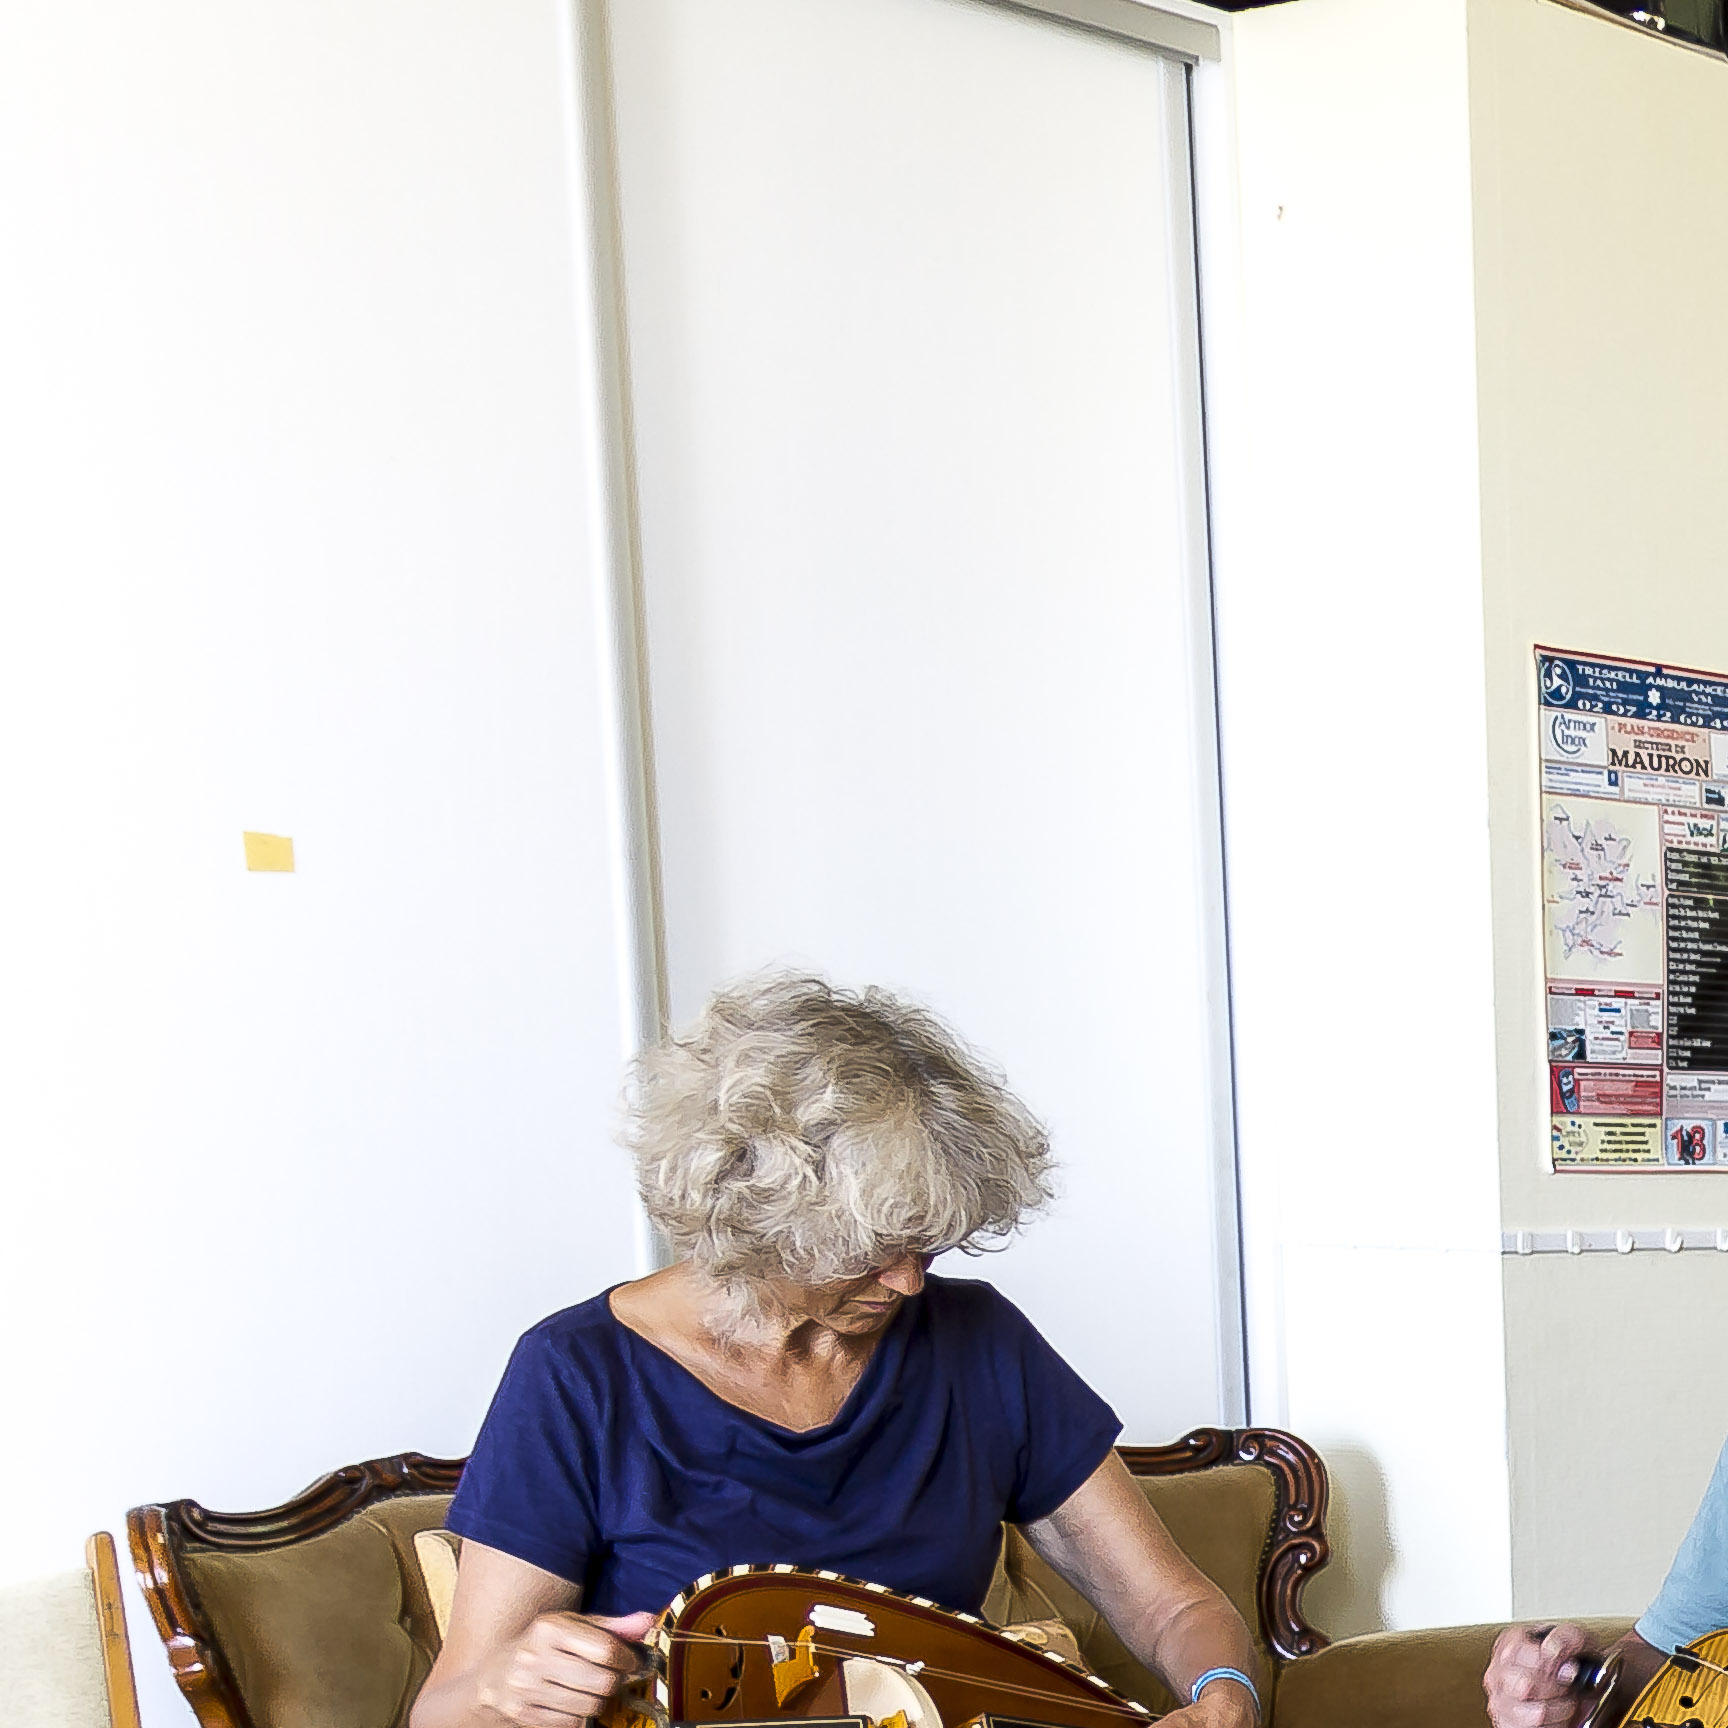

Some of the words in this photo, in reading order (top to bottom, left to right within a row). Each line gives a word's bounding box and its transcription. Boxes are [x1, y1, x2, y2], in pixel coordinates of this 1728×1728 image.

[1576, 664, 1640, 684] TRISKELL
[1588, 677, 1618, 690] TAXI
[1577, 699, 1604, 713] 02
[1611, 703, 1637, 717] 97
[1645, 708, 1672, 722] 22
[1559, 713, 1597, 733] Armor
[1561, 729, 1589, 749] Inox
[1609, 748, 1710, 778] MAURON
